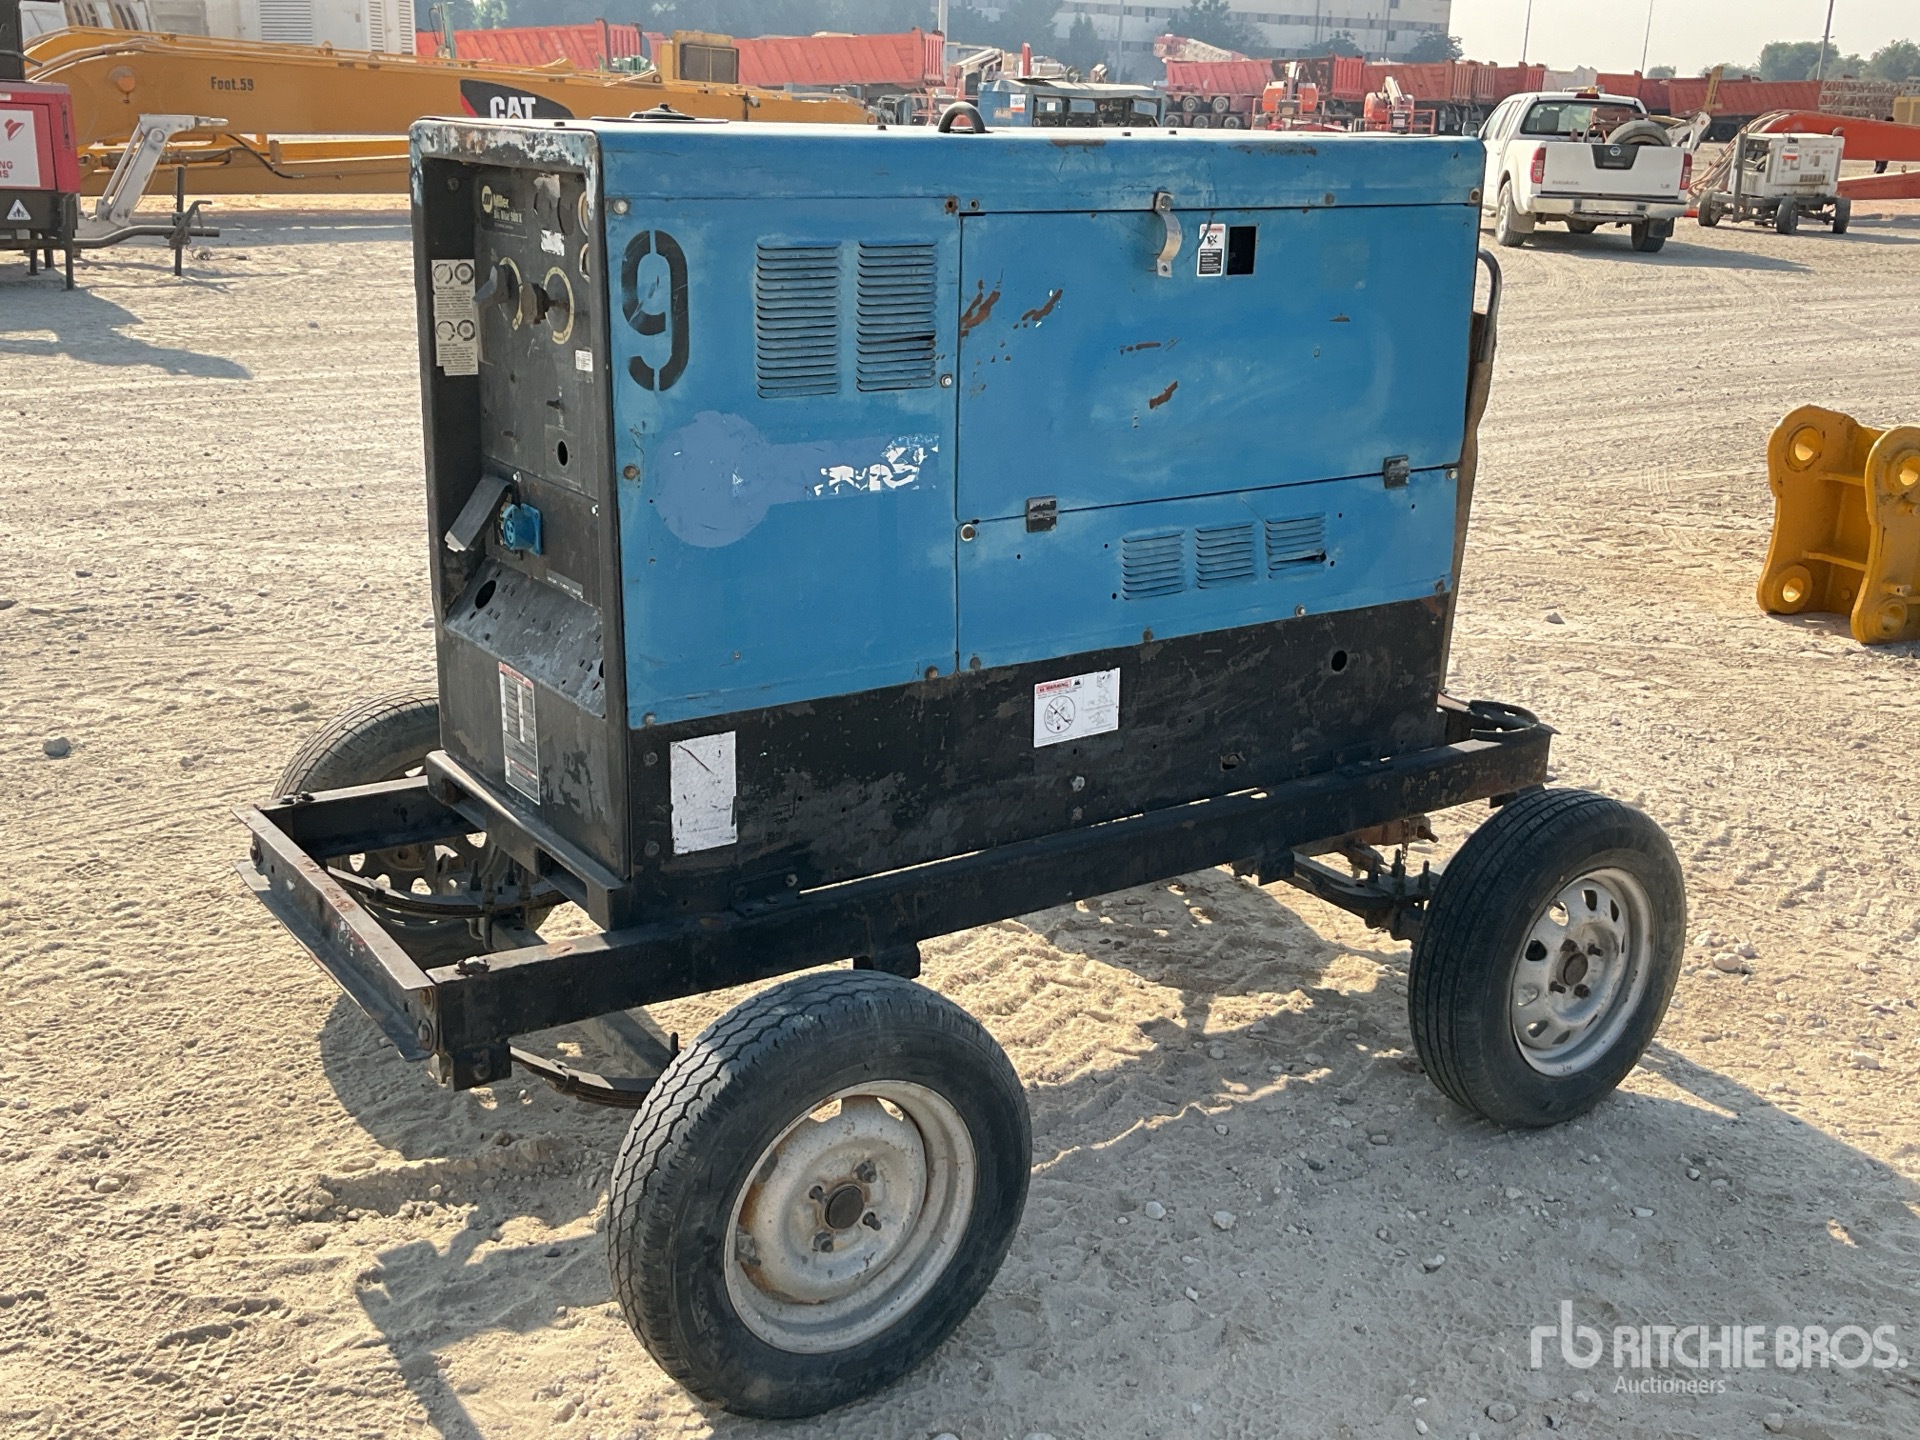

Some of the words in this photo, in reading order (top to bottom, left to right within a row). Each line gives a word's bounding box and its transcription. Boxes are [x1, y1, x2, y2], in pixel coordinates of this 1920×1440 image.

[210, 76, 254, 91] Foot.59
[489, 96, 536, 119] CAT
[621, 229, 690, 392] 9
